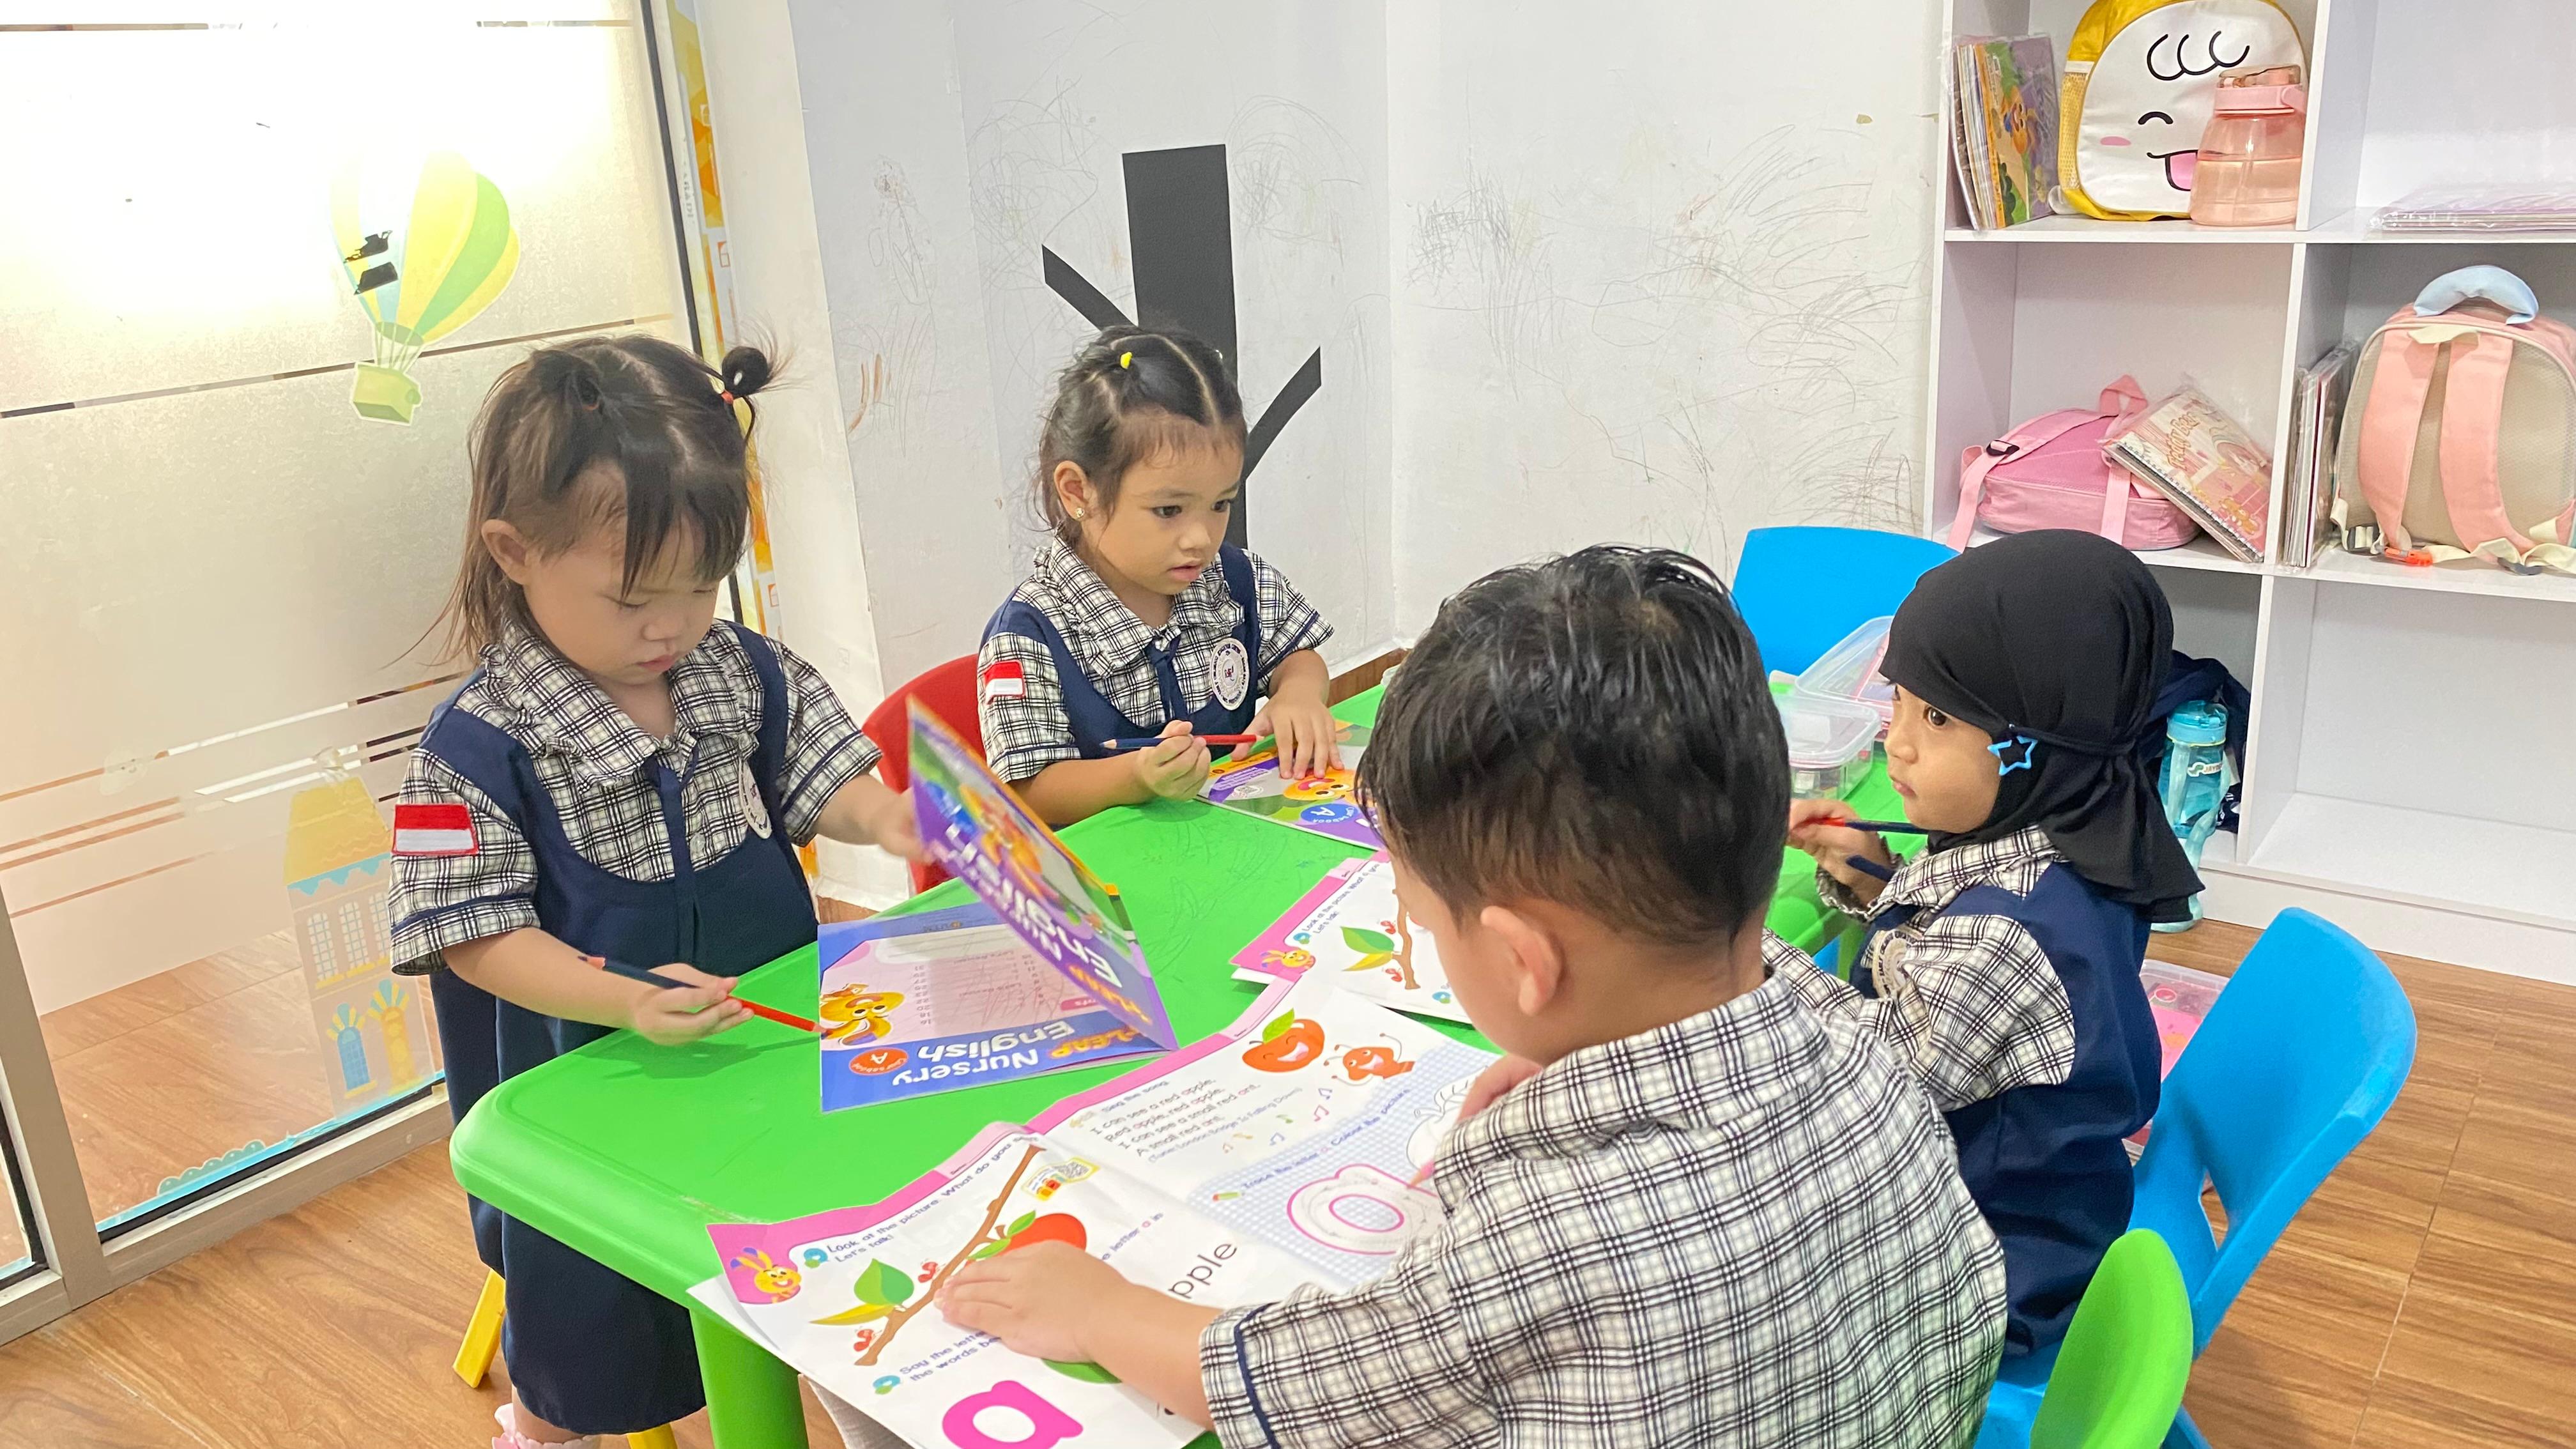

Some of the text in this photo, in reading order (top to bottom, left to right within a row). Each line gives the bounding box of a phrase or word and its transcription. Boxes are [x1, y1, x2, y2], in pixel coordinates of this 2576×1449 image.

[1310, 807, 1335, 816] A
[870, 1052, 889, 1065] A
[917, 1020, 1077, 1061] English
[892, 1048, 1039, 1086] Nursery
[1091, 1127, 1102, 1136] I
[1103, 1117, 1126, 1128] can
[1127, 1108, 1147, 1119] see
[1159, 1093, 1180, 1106] red
[1181, 1078, 1216, 1096] apple.
[1105, 1126, 1131, 1142] Red
[1168, 1103, 1190, 1116] red
[1190, 1087, 1225, 1105] apple.
[1118, 1141, 1131, 1150] I
[1131, 1131, 1155, 1143] can
[1155, 1122, 1176, 1133] see
[1188, 1104, 1216, 1119] small
[1216, 1093, 1238, 1107] red
[1136, 1147, 1149, 1157] A
[1149, 1134, 1178, 1150] small
[1179, 1124, 1200, 1137] red
[826, 1239, 859, 1254] Look
[862, 1232, 875, 1242] at
[876, 1222, 898, 1234] the
[899, 1197, 942, 1225] picture.
[940, 1174, 974, 1197] What
[975, 1162, 990, 1176] do
[991, 1143, 1012, 1162] you
[834, 1234, 894, 1263] Let's talk!
[1109, 1227, 1140, 1252] letter
[1151, 1213, 1164, 1222] in
[1168, 1243, 1238, 1300] pple
[900, 1330, 988, 1375] Say the lette
[910, 1369, 934, 1381] the
[935, 1347, 979, 1369] words
[942, 1379, 1084, 1449] a
